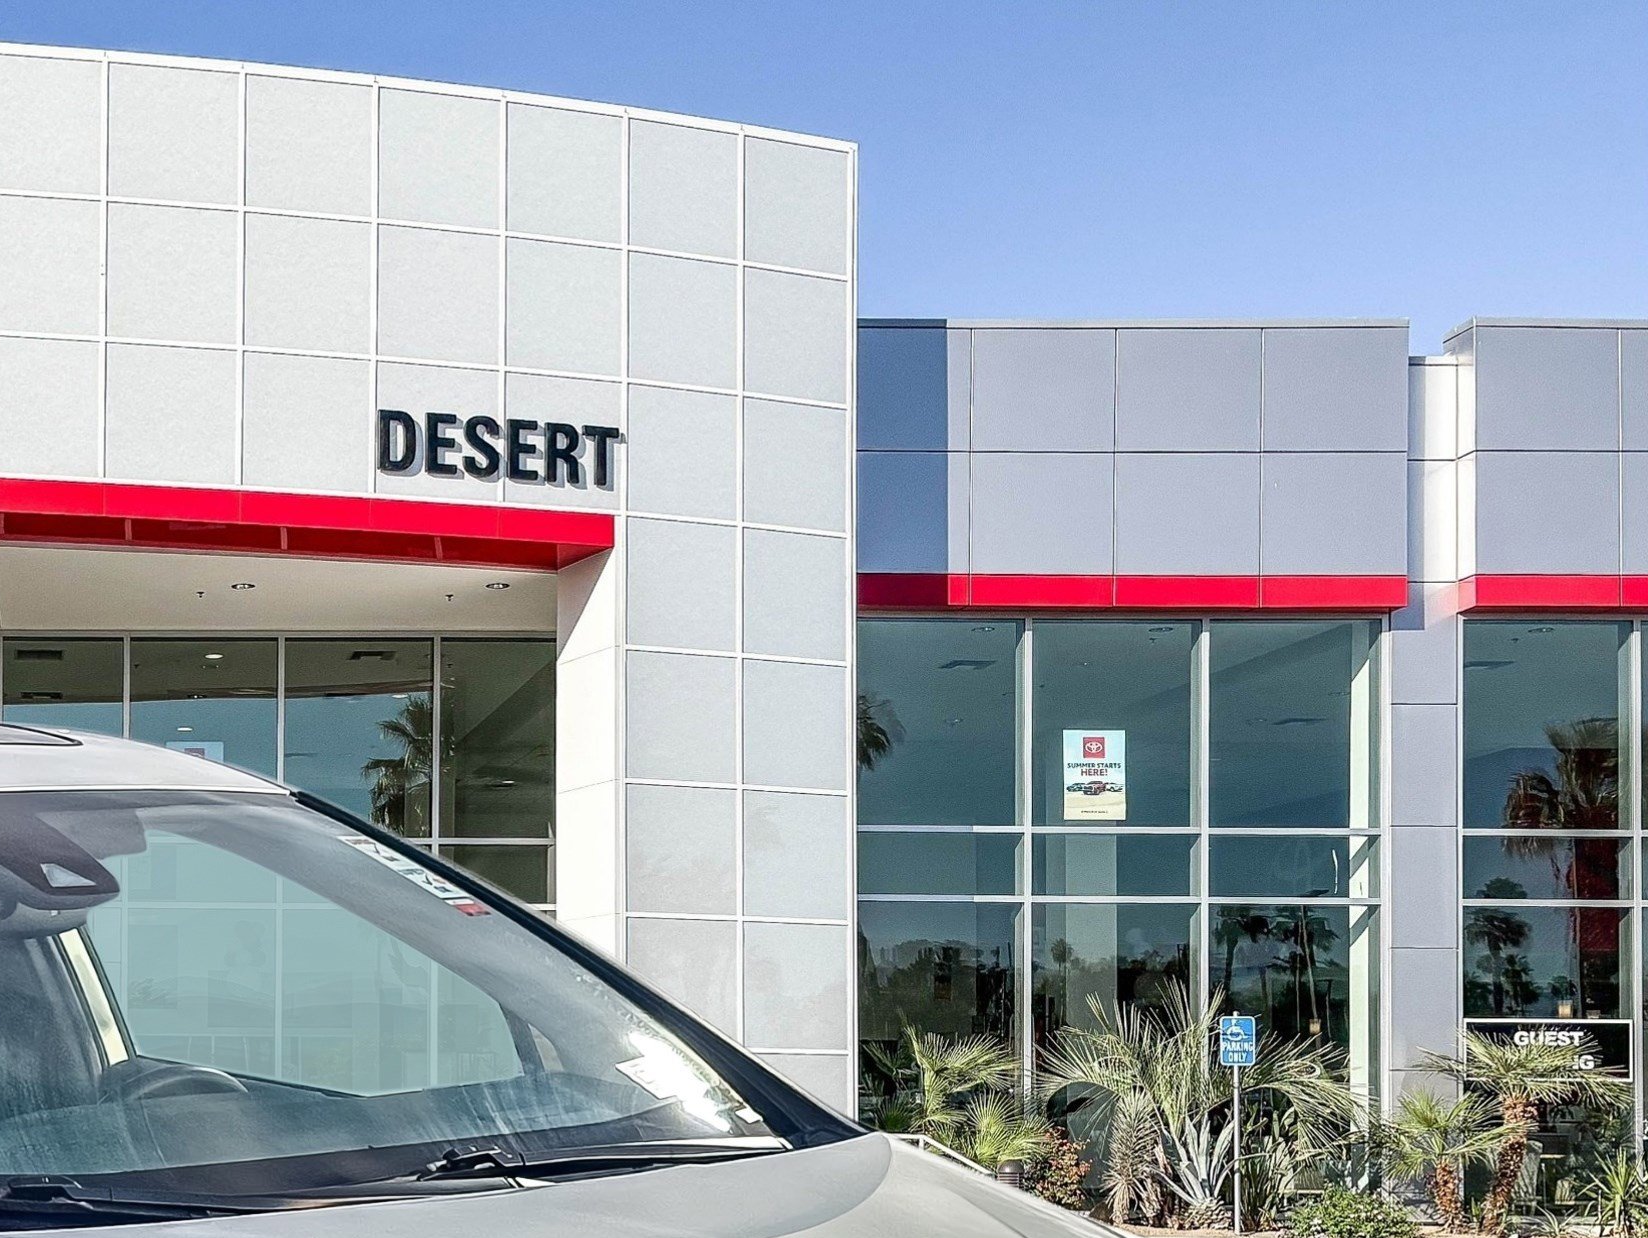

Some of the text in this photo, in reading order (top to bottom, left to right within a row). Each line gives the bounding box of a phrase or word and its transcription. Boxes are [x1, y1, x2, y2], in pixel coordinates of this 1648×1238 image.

[377, 409, 620, 487] DESERT
[1080, 768, 1108, 777] HERE!
[1513, 1031, 1584, 1046] GUEST
[1221, 1041, 1254, 1051] PARKING
[1228, 1051, 1248, 1062] ONLY
